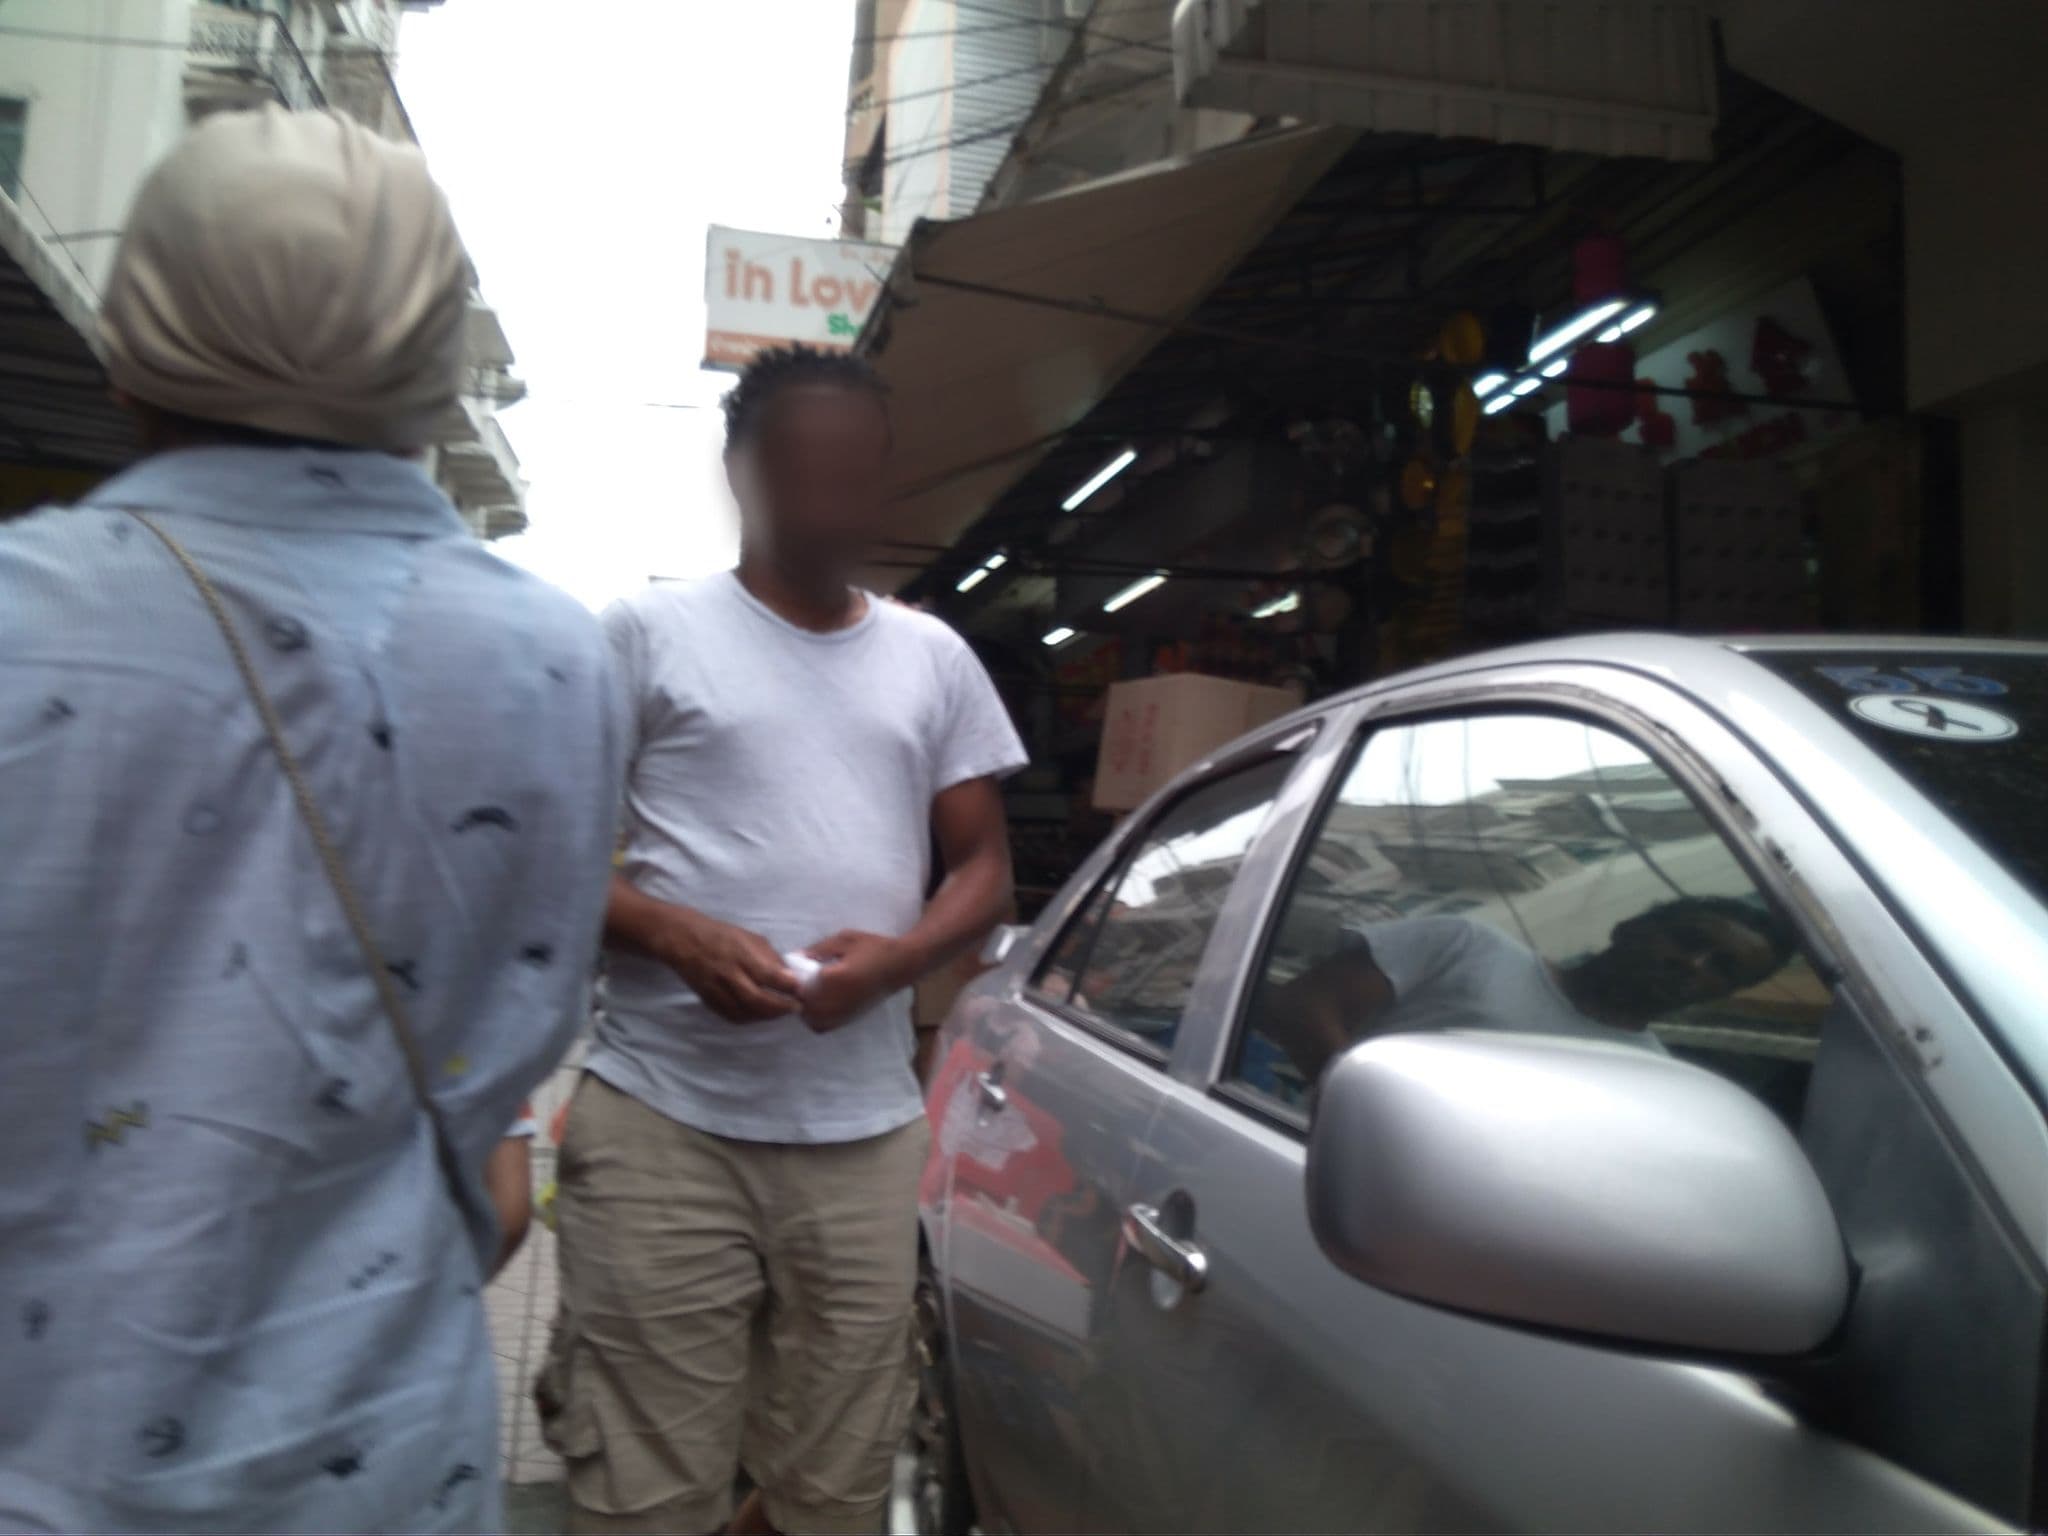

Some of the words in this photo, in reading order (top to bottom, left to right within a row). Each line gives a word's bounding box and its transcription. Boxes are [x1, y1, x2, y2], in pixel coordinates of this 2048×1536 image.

[724, 248, 774, 304] in
[789, 257, 878, 314] Lov
[827, 313, 862, 336] Sh
